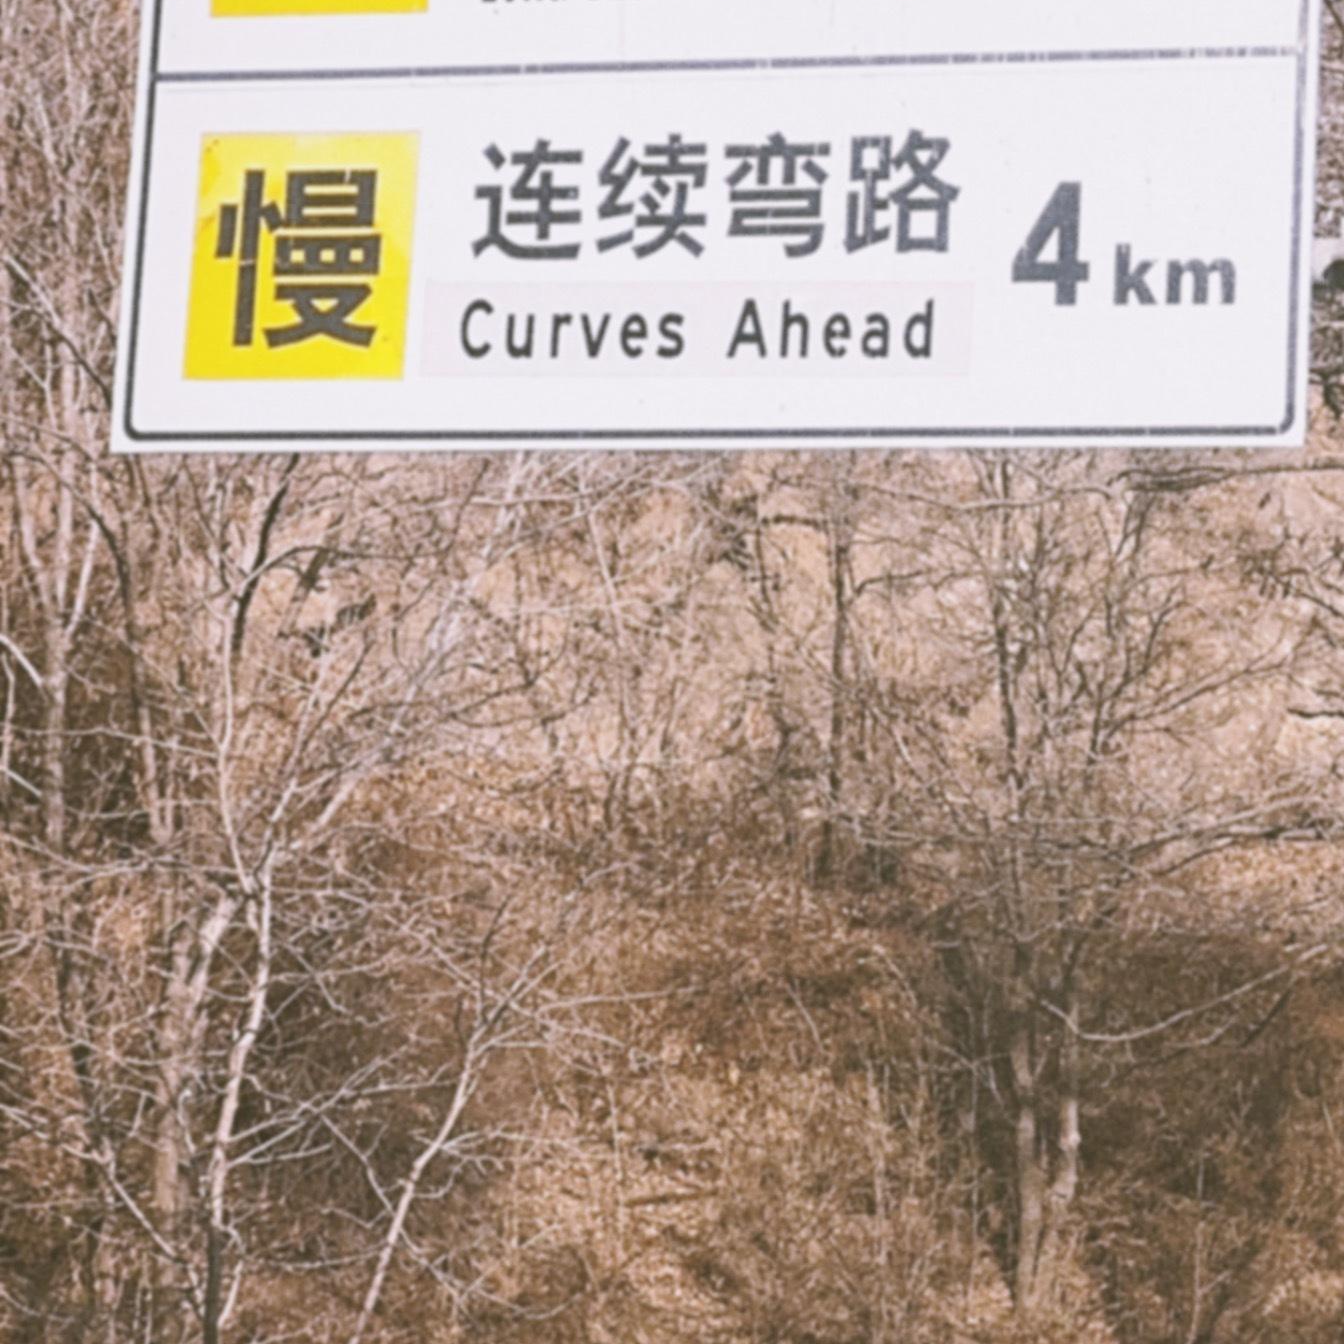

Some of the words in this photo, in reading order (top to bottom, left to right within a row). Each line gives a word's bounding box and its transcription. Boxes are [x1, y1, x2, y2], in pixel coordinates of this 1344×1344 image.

[215, 169, 382, 348] 慢
[472, 130, 960, 261] 连续弯路
[1012, 182, 1090, 306] 4
[1114, 243, 1236, 305] km
[460, 298, 685, 360] Curves
[726, 298, 936, 359] Ahead
